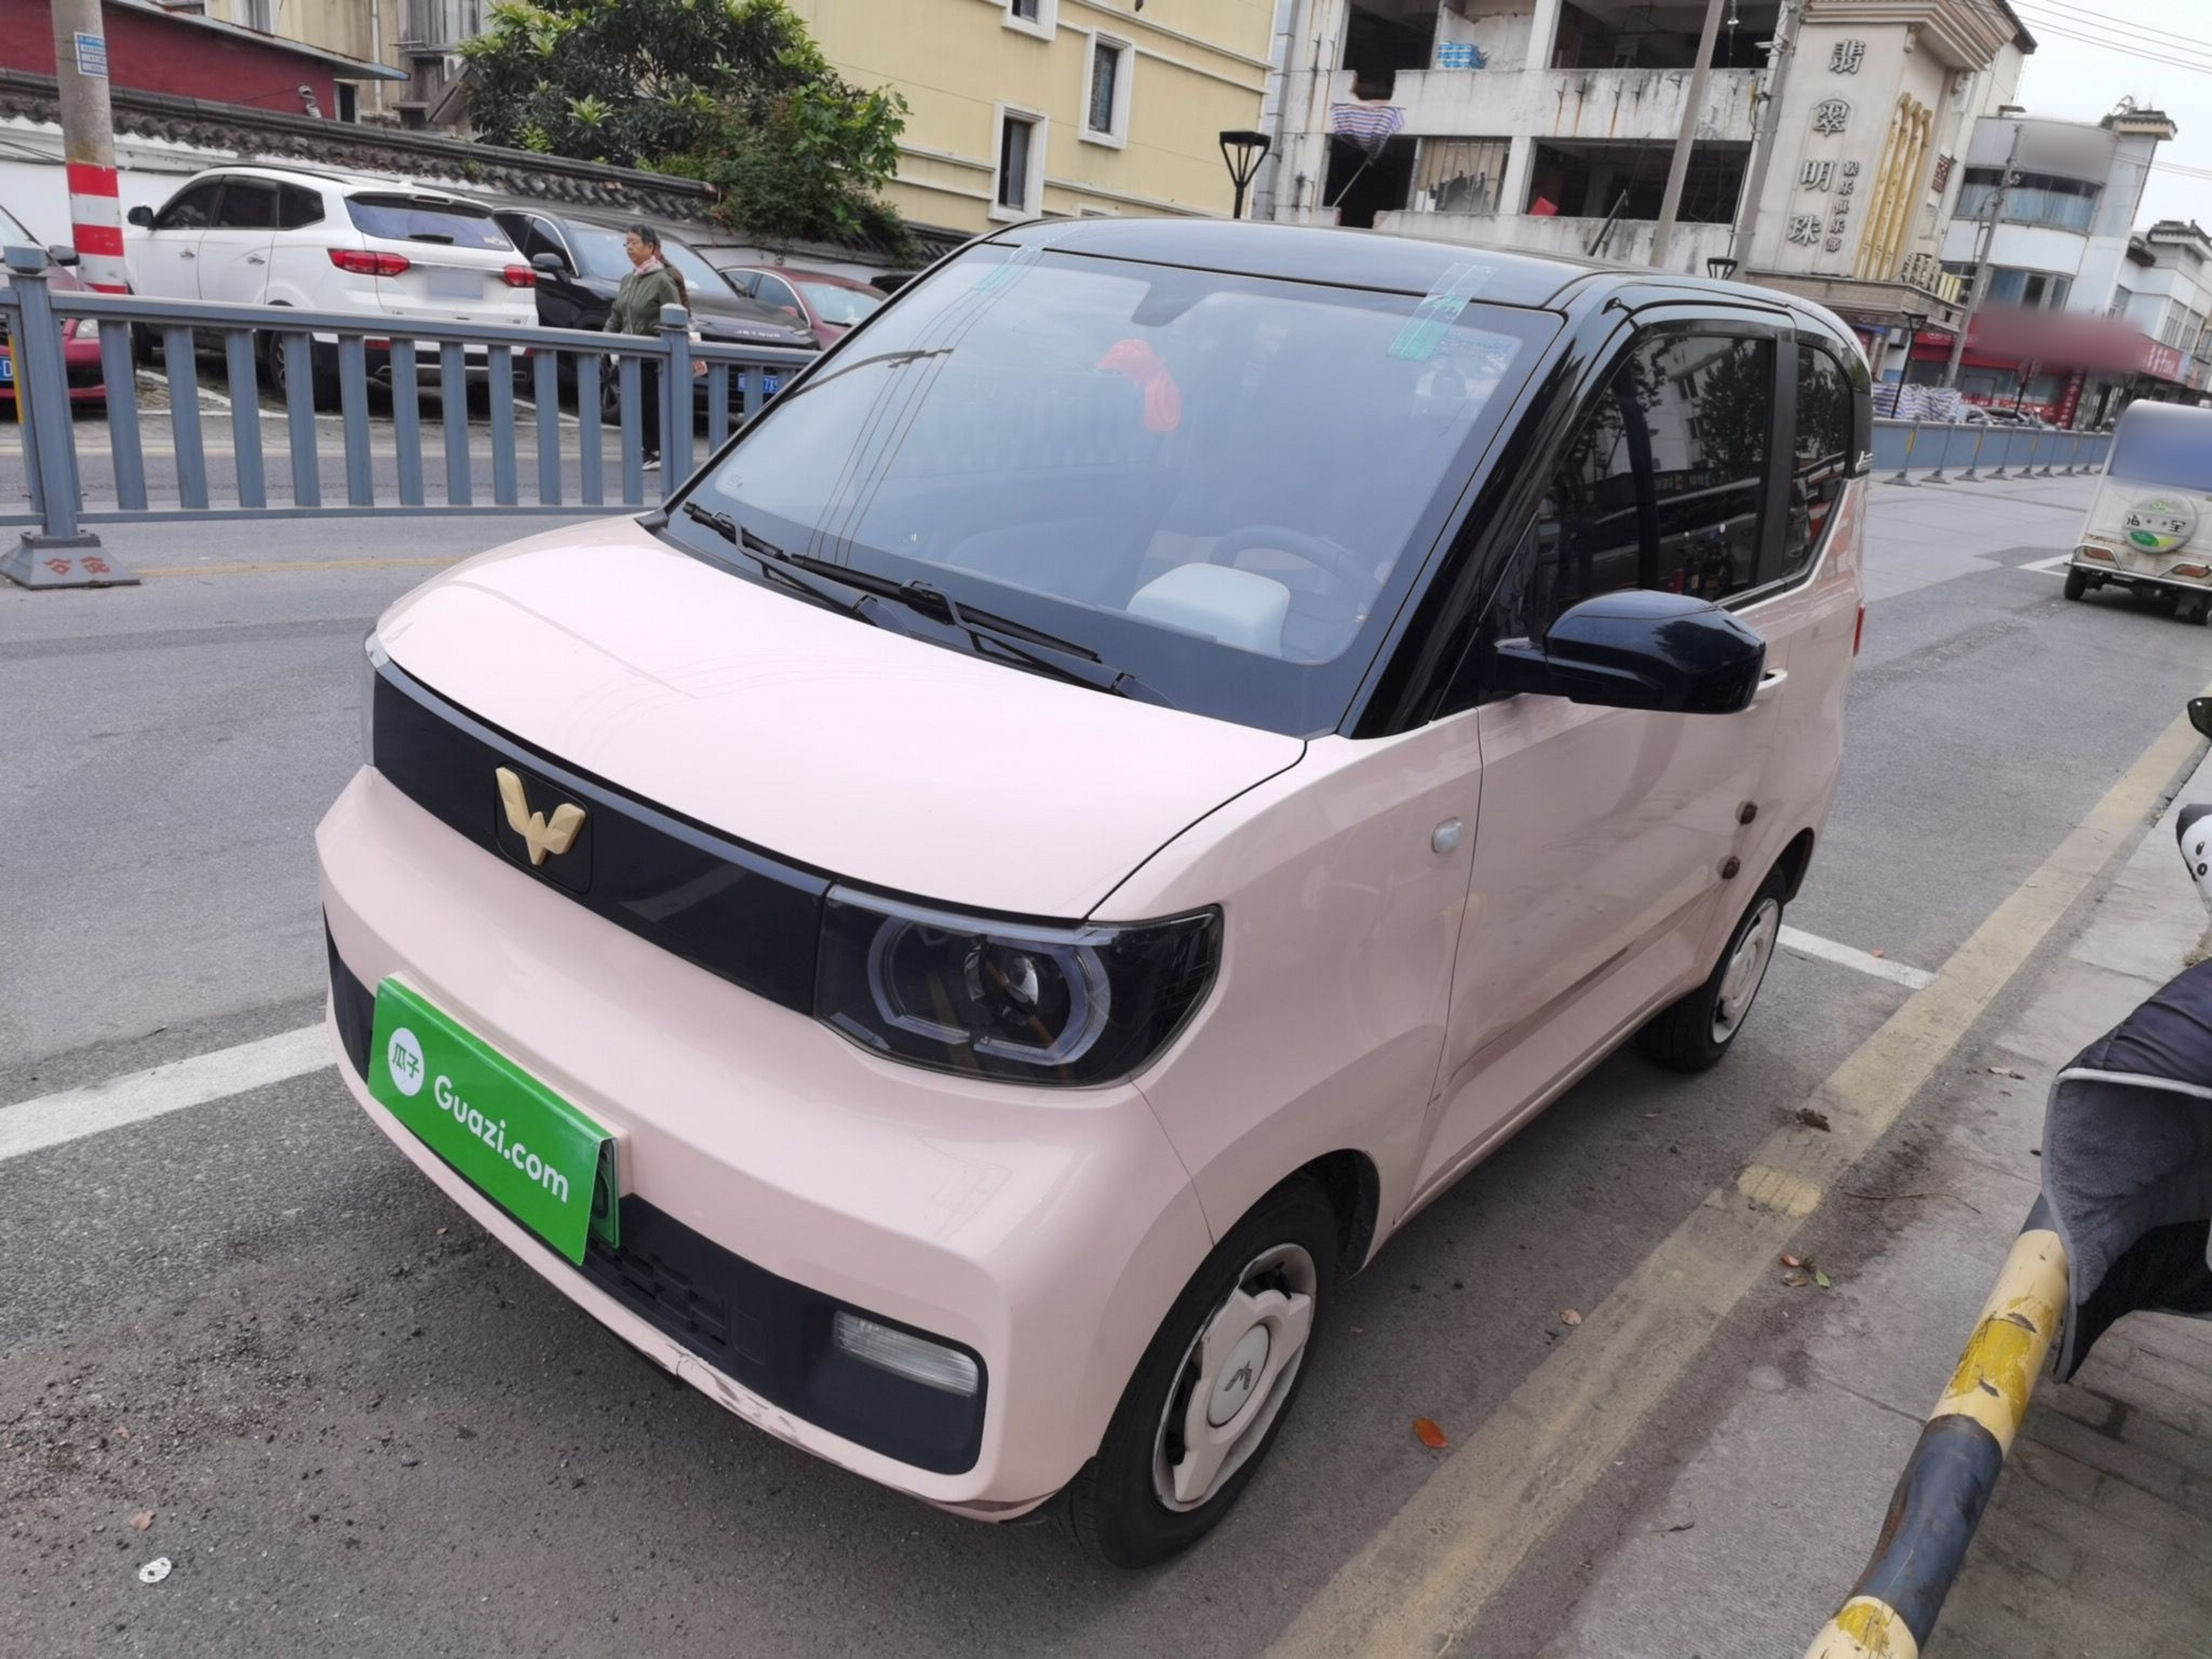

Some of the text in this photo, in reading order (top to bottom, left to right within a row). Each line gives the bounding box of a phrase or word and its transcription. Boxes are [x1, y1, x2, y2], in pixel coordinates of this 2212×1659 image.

[1788, 39, 1866, 246] 翡翠明珠
[393, 1042, 420, 1080] 瓜子
[434, 1074, 569, 1204] Guazi.com
